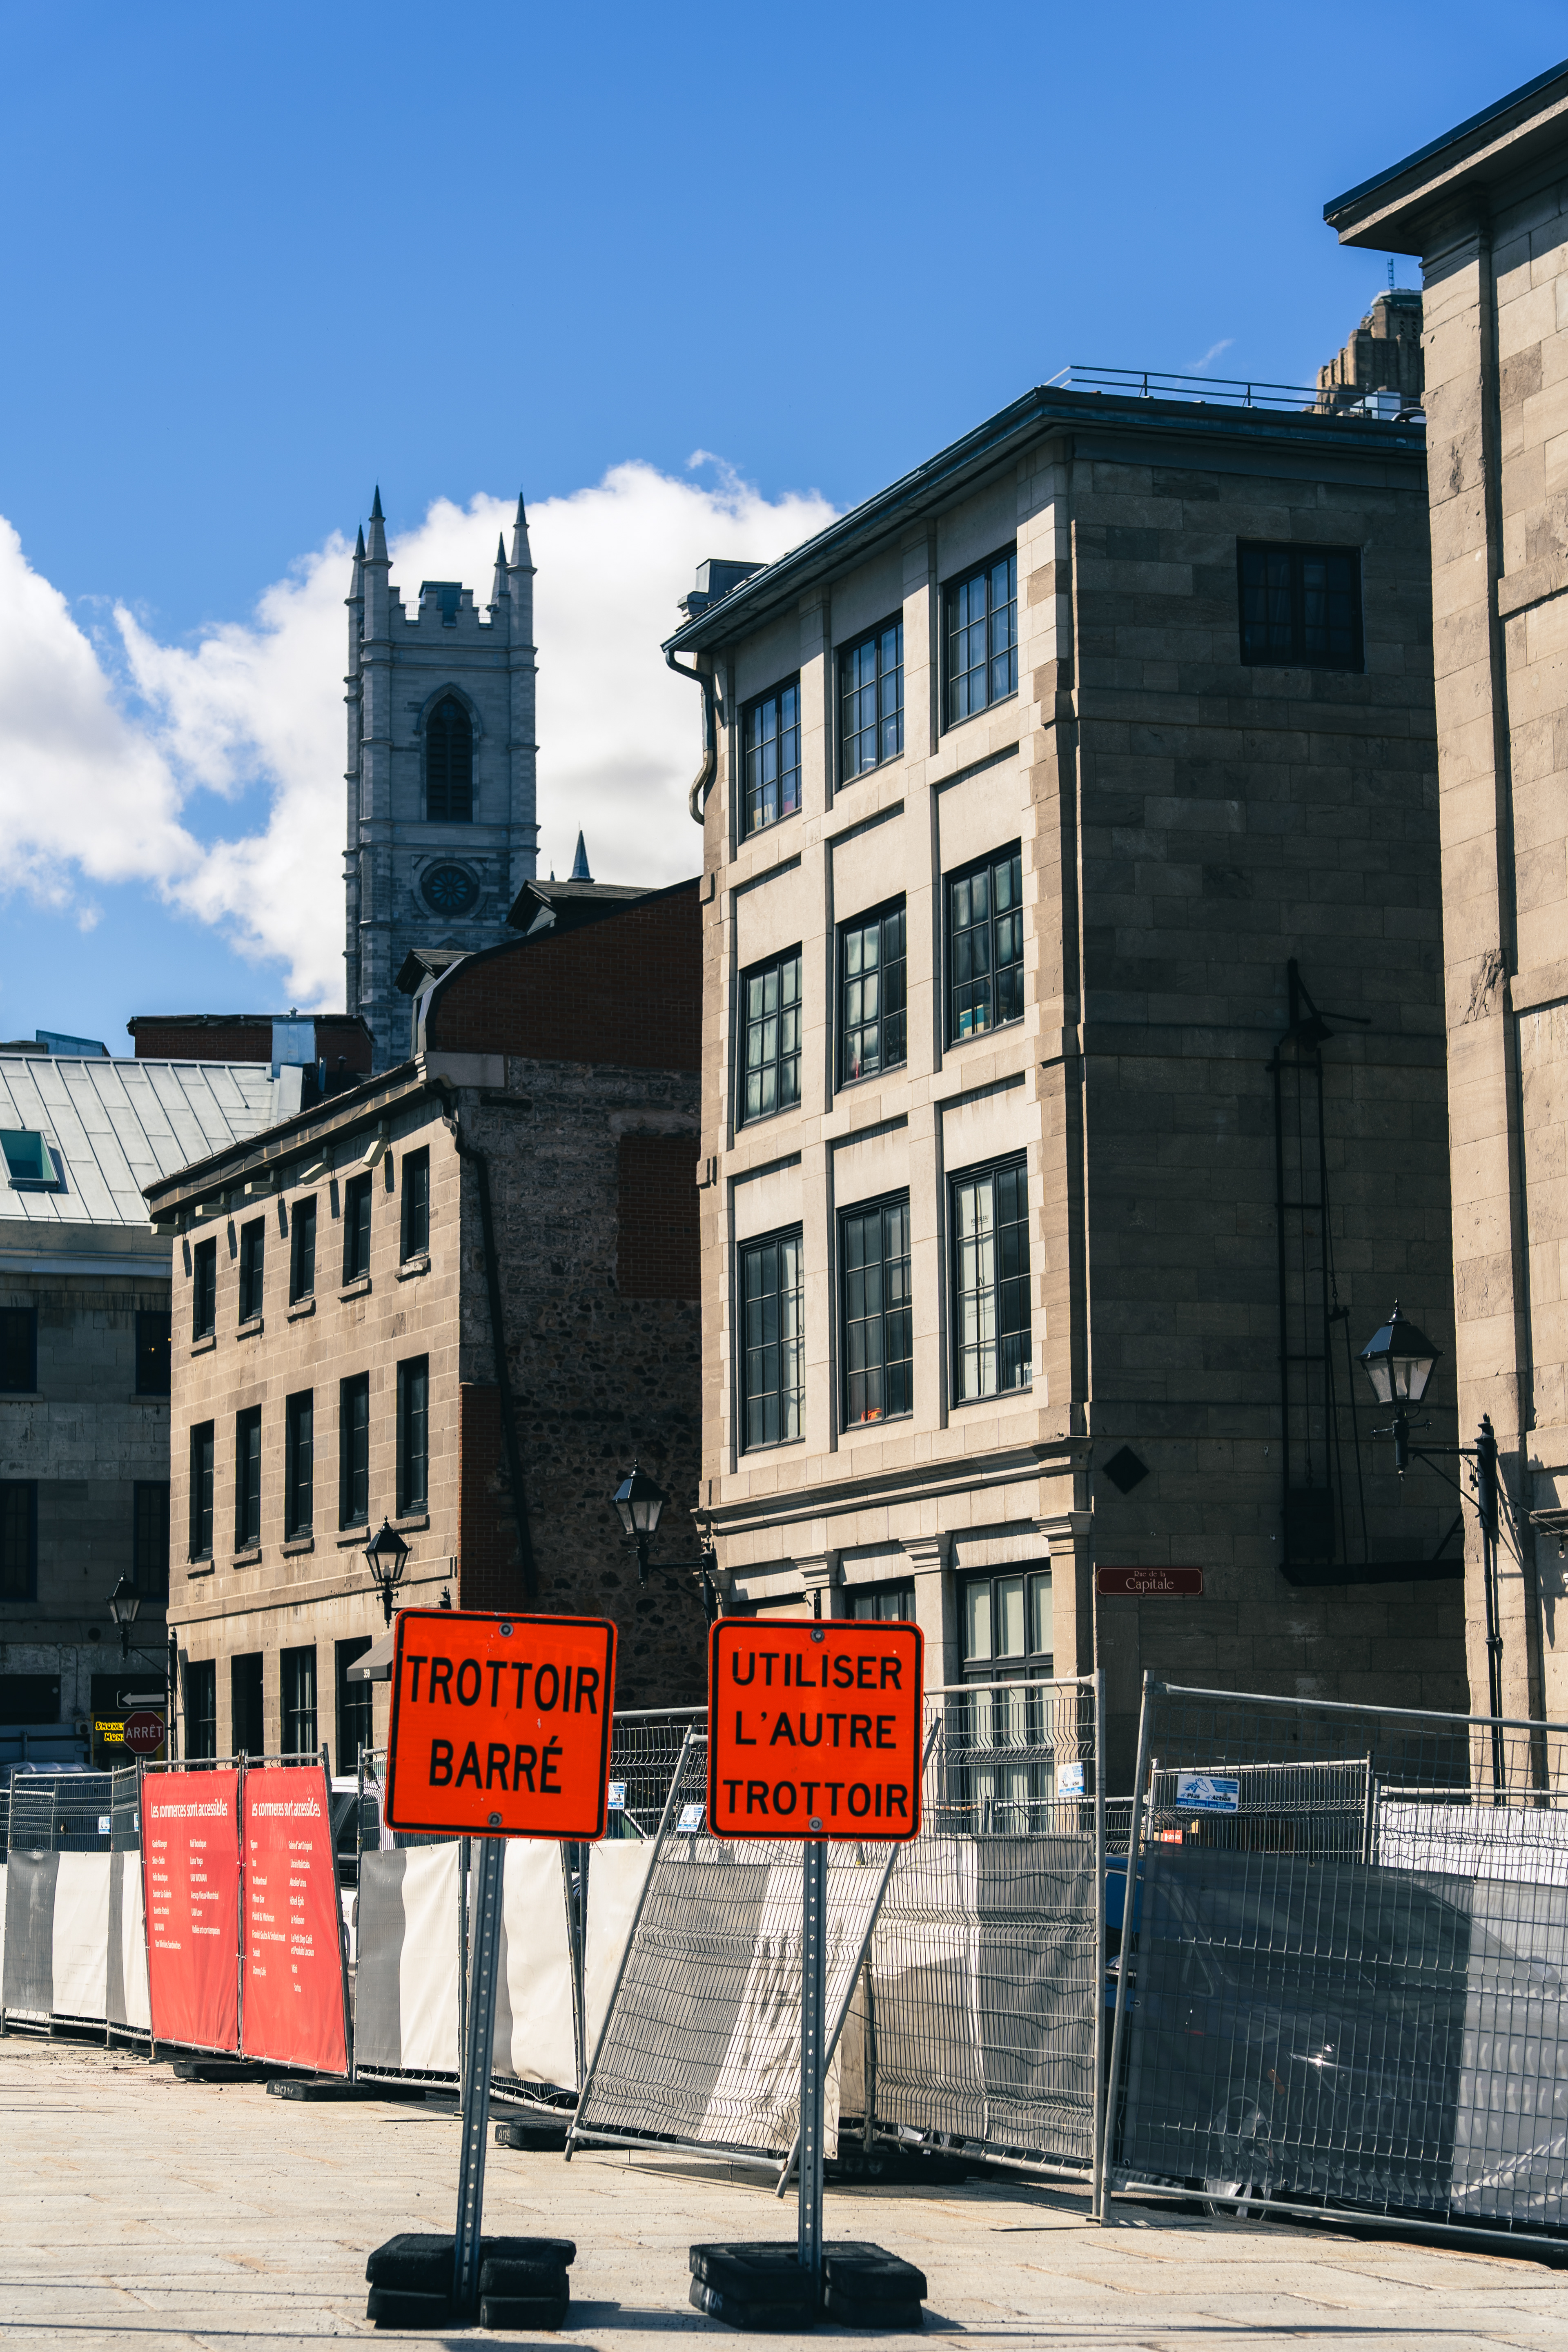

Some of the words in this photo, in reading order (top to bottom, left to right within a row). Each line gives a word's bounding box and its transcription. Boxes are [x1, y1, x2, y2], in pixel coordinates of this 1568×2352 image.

[1126, 1578, 1174, 1593] Capitale
[732, 1652, 902, 1690] UTILISER
[407, 1655, 599, 1715] TROTTOIR
[126, 1724, 162, 1739] ARRÊT
[735, 1711, 896, 1749] L'AUTRE
[429, 1736, 563, 1795] BARRÉ
[723, 1780, 908, 1817] TROTTOIR
[160, 1804, 186, 1817] commerces
[187, 1801, 198, 1817] sont
[198, 1798, 227, 1817] accessibles
[195, 1839, 207, 1849] boutique
[196, 1873, 207, 1882] WOMAN
[199, 1891, 219, 1900] Vieux-Montréal
[291, 1934, 294, 1942] Le
[291, 1946, 294, 1954] et
[294, 1946, 304, 1956] Produits
[304, 1947, 314, 1956] Locaux
